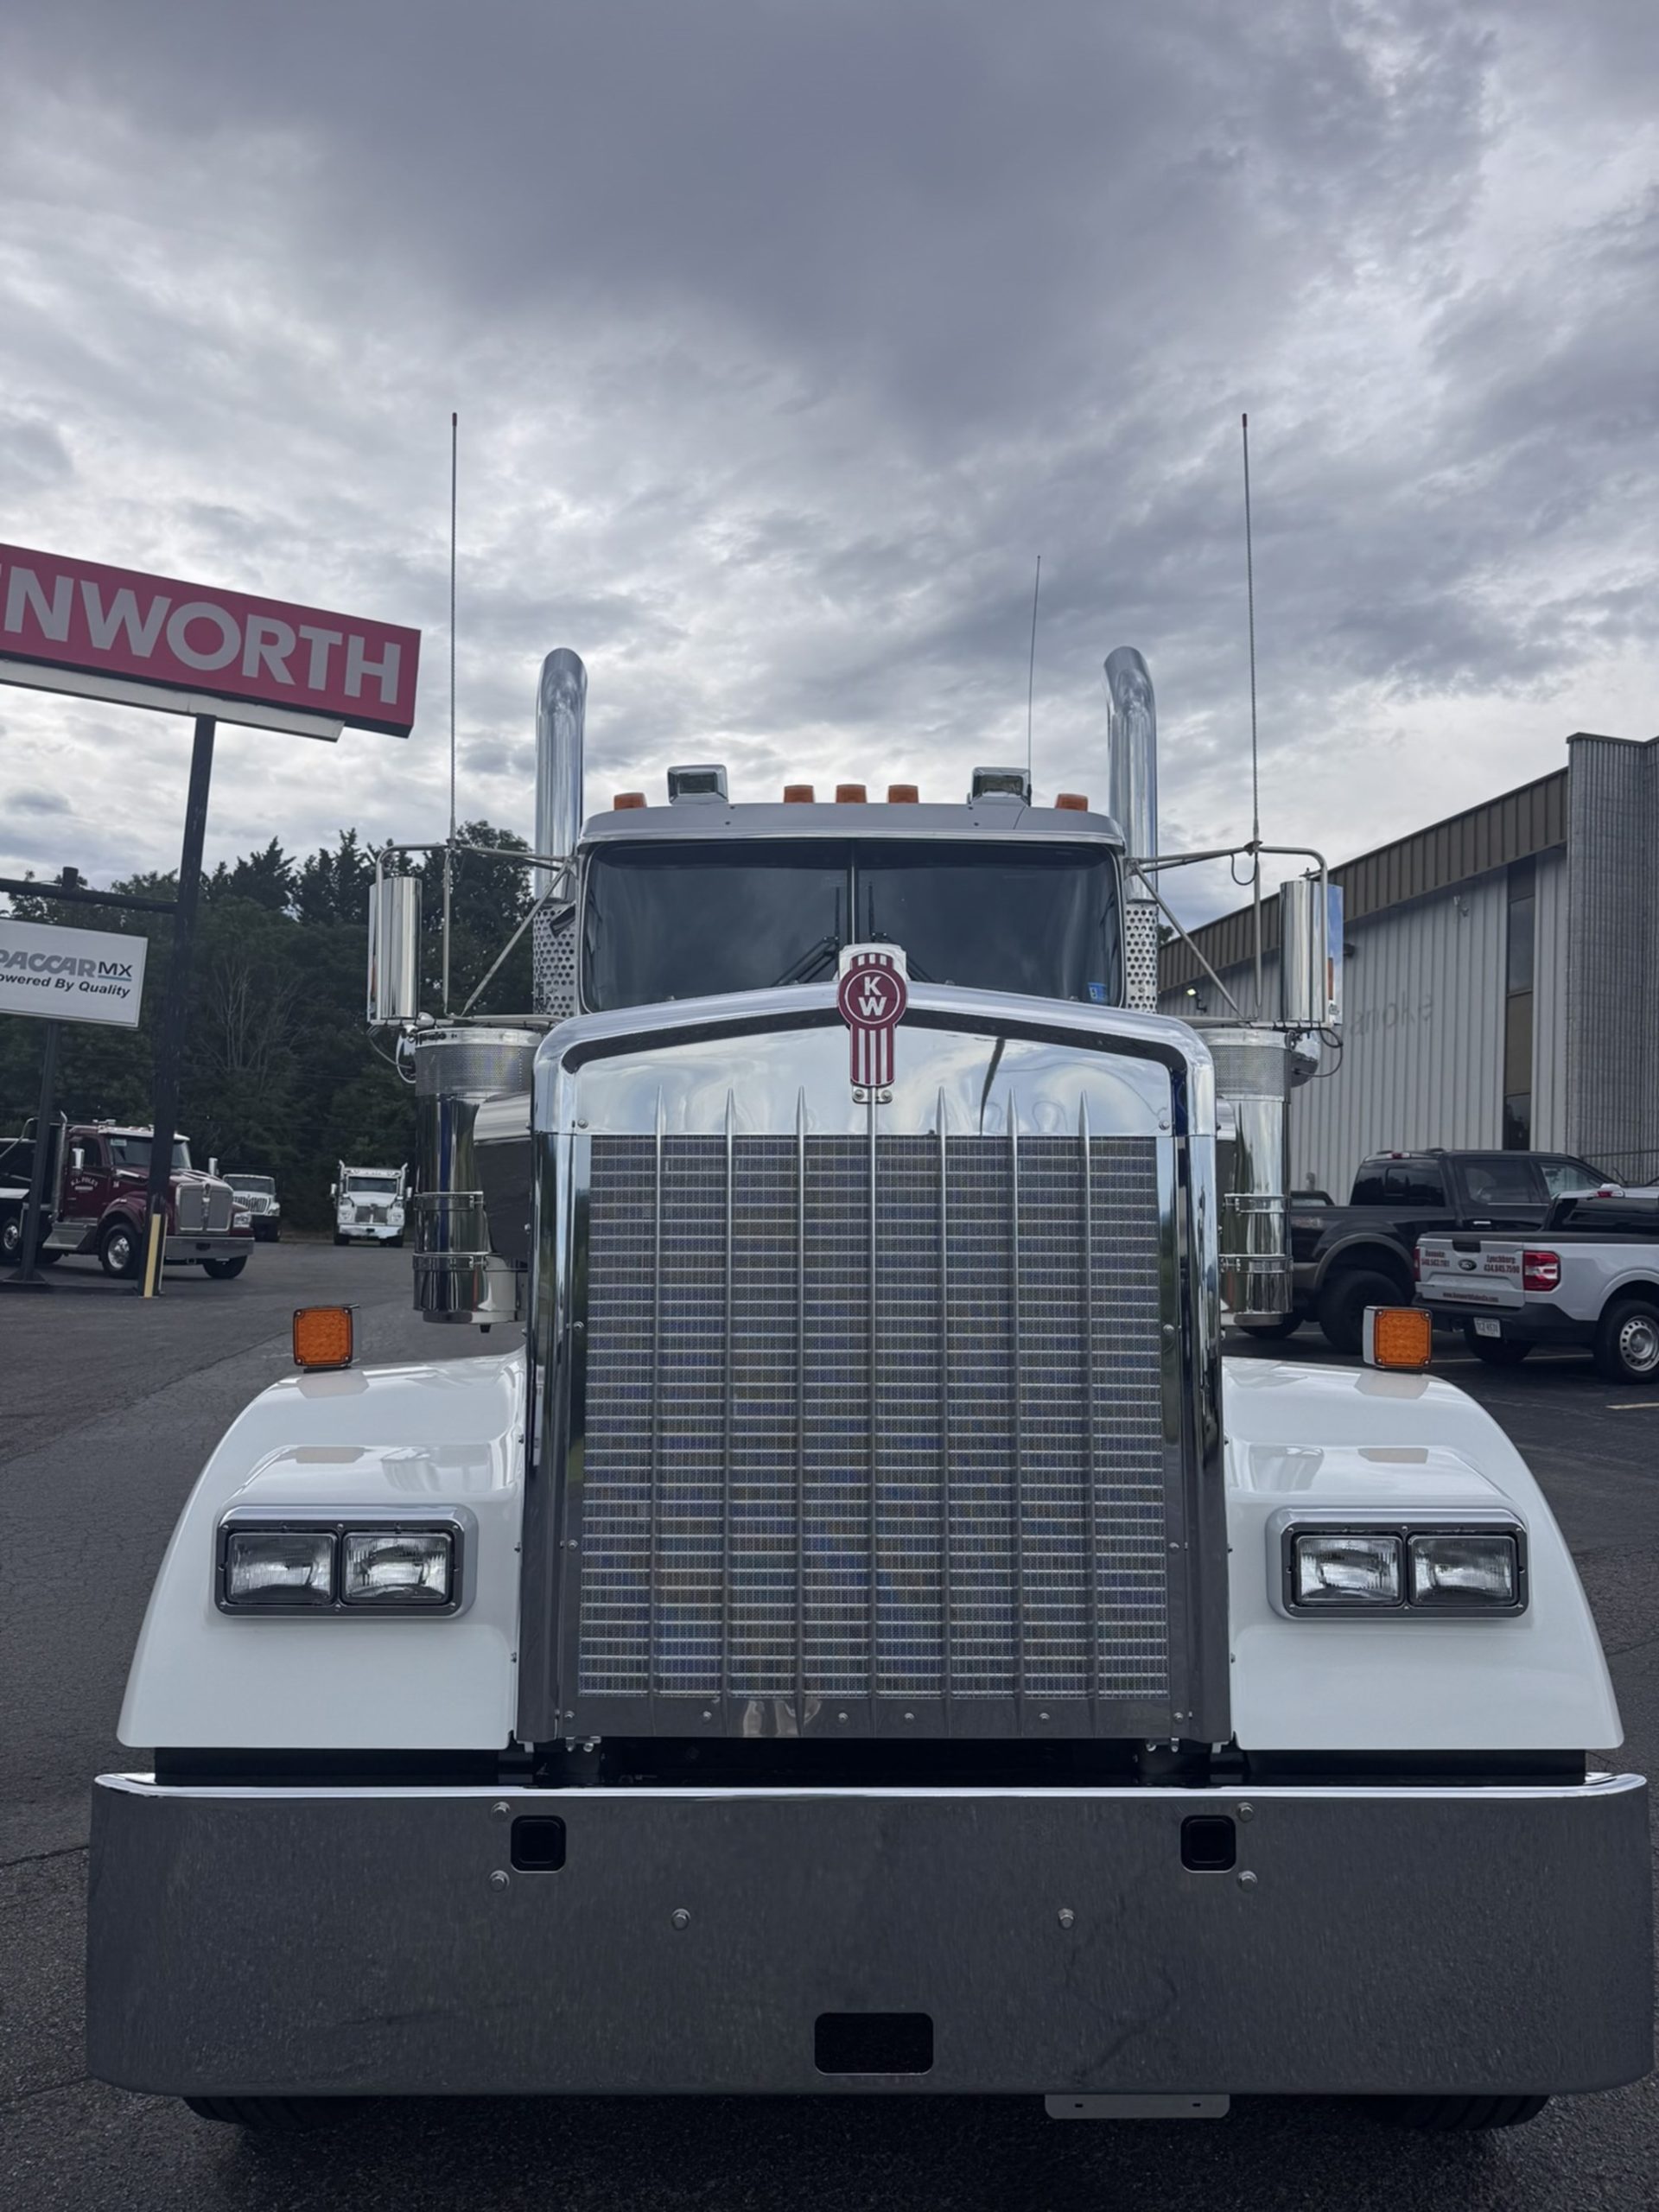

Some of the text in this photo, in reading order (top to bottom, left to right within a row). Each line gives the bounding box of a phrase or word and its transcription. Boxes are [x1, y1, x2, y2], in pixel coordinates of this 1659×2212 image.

[0, 563, 402, 705] NWORTH
[0, 973, 130, 999] owered By Quality
[865, 976, 882, 995] K
[858, 996, 887, 1016] W
